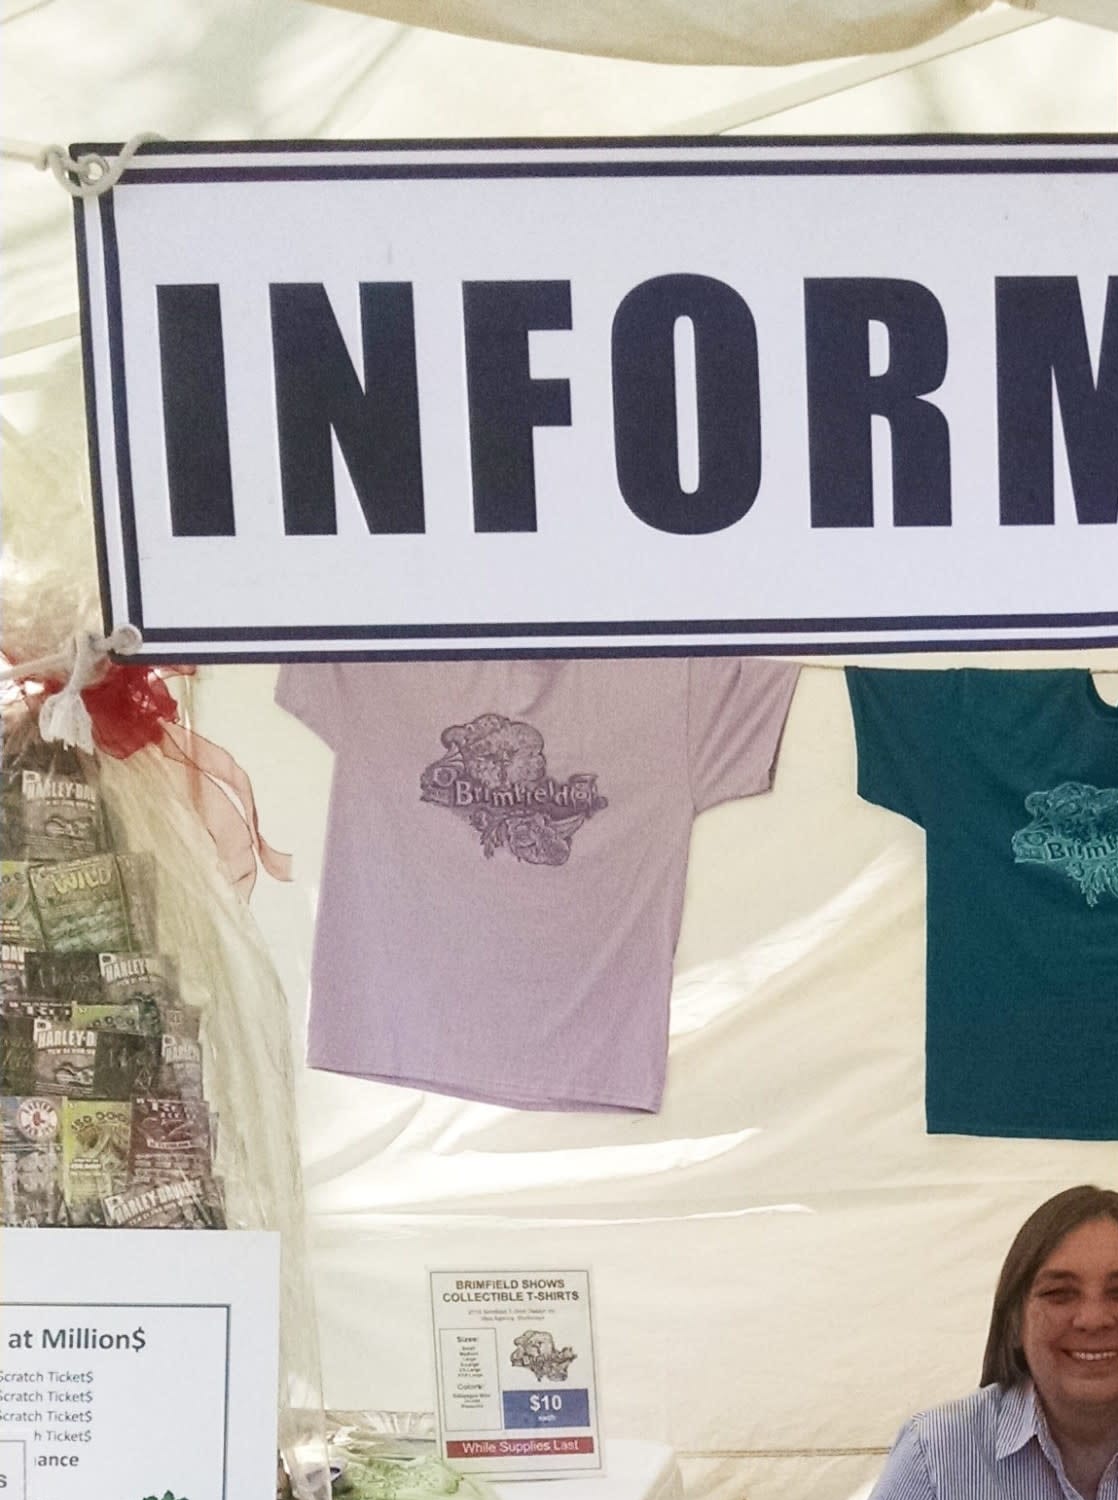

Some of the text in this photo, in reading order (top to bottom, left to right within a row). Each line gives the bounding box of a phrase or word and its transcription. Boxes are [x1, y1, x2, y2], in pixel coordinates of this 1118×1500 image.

[456, 1279, 565, 1290] BRIMFIELD SHOWS
[443, 1290, 579, 1302] COLLECTIBLE T-SHIRTS
[8, 1326, 146, 1353] at Million$
[530, 1394, 562, 1412] $10
[462, 1438, 579, 1454] While Supplies Last
